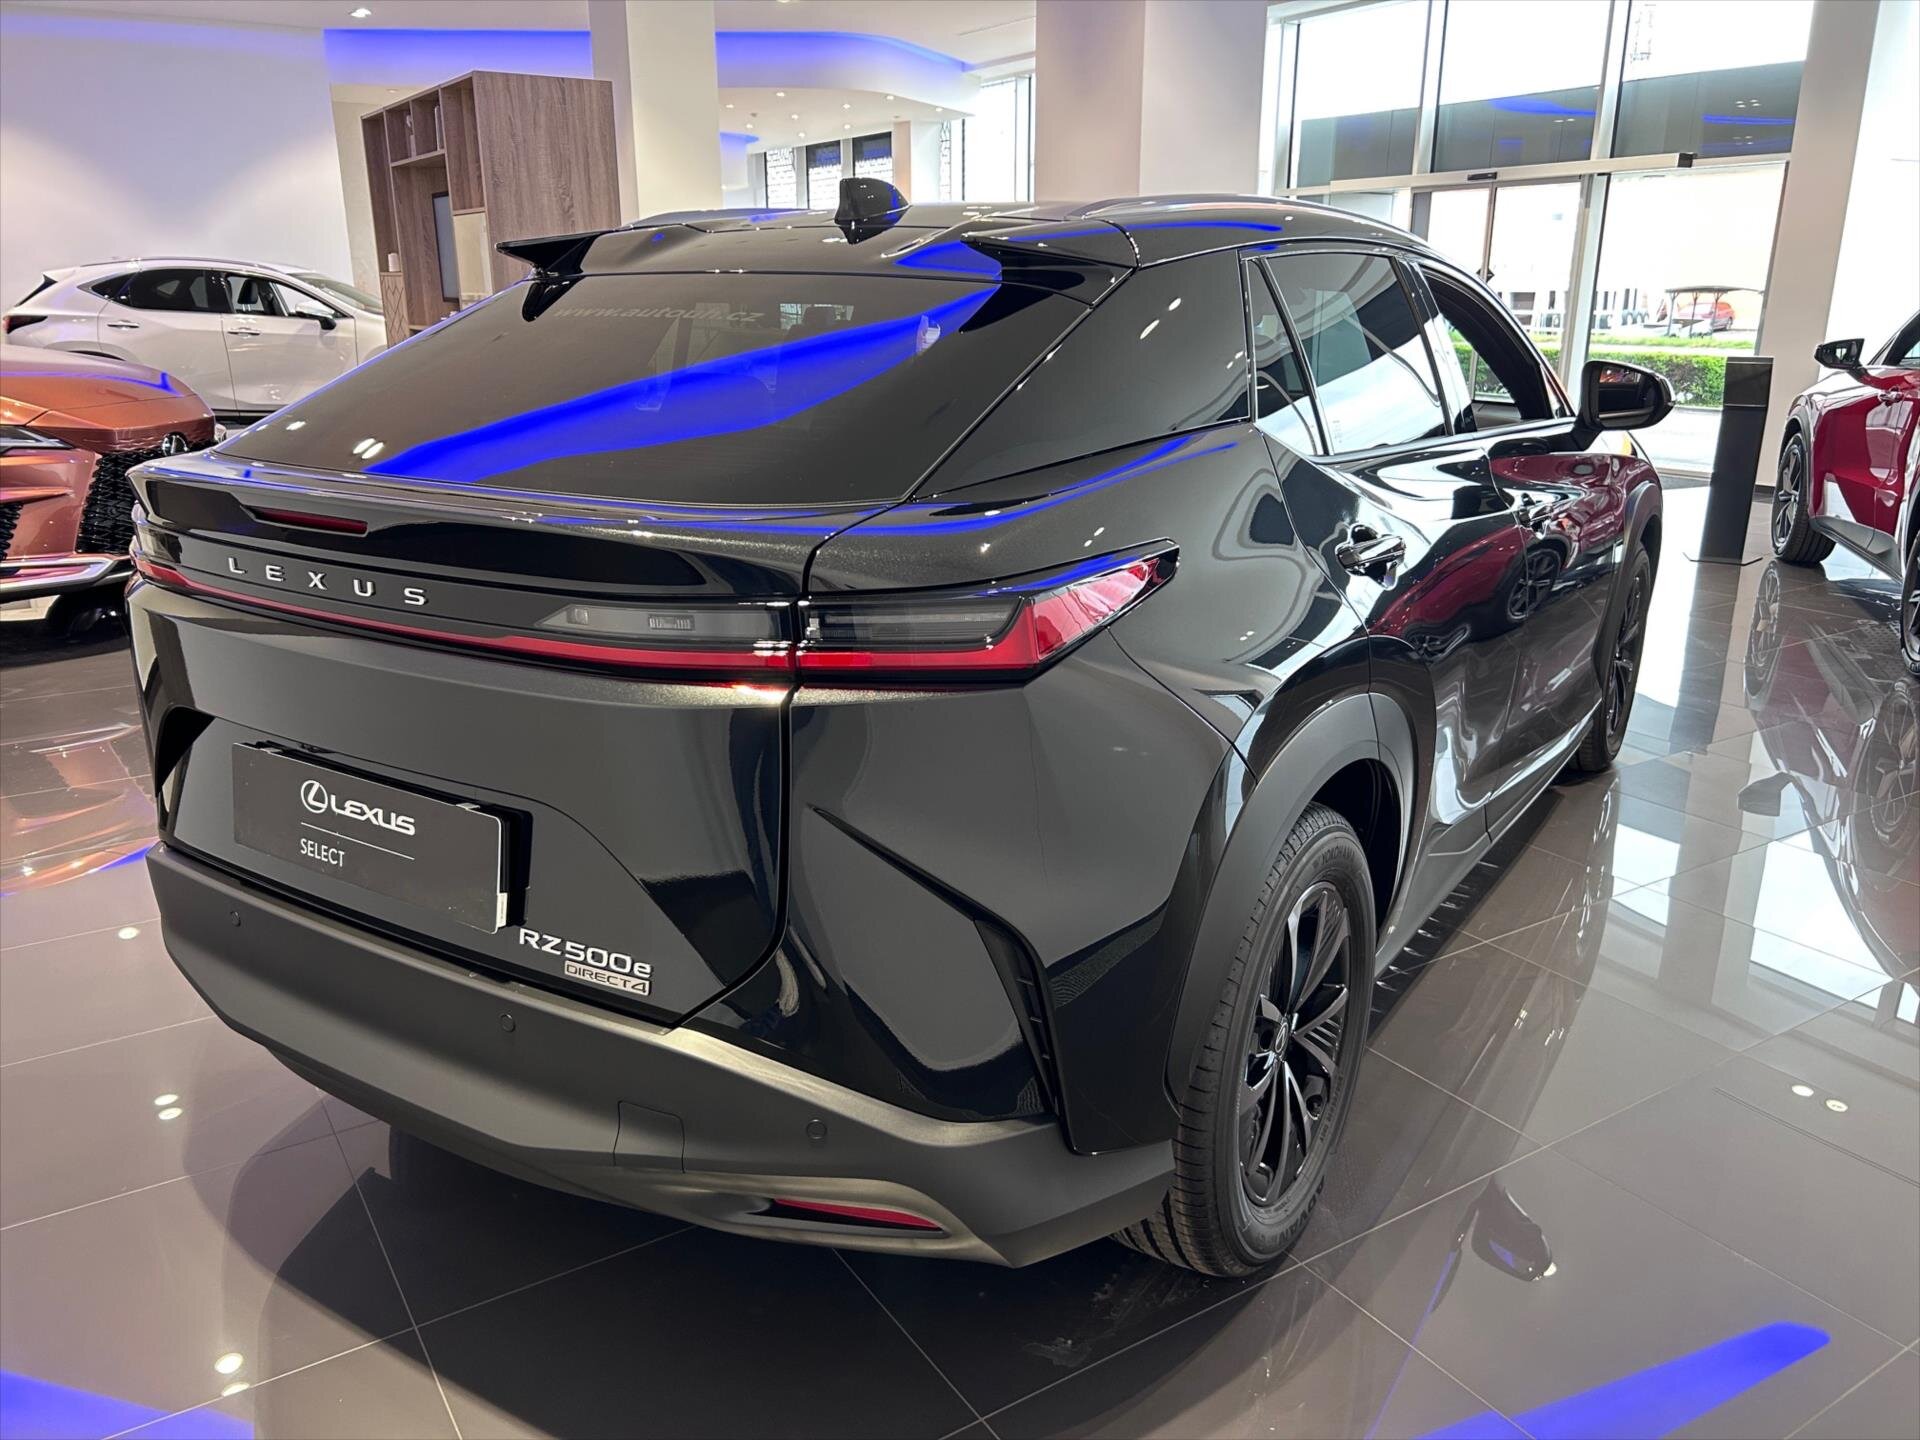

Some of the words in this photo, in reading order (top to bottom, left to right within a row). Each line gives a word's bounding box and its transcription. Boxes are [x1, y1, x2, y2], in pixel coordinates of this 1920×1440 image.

[228, 557, 428, 606] LEXUS
[330, 794, 416, 836] LEXUS
[300, 838, 345, 867] SELECT
[566, 964, 648, 993] DIRECT4
